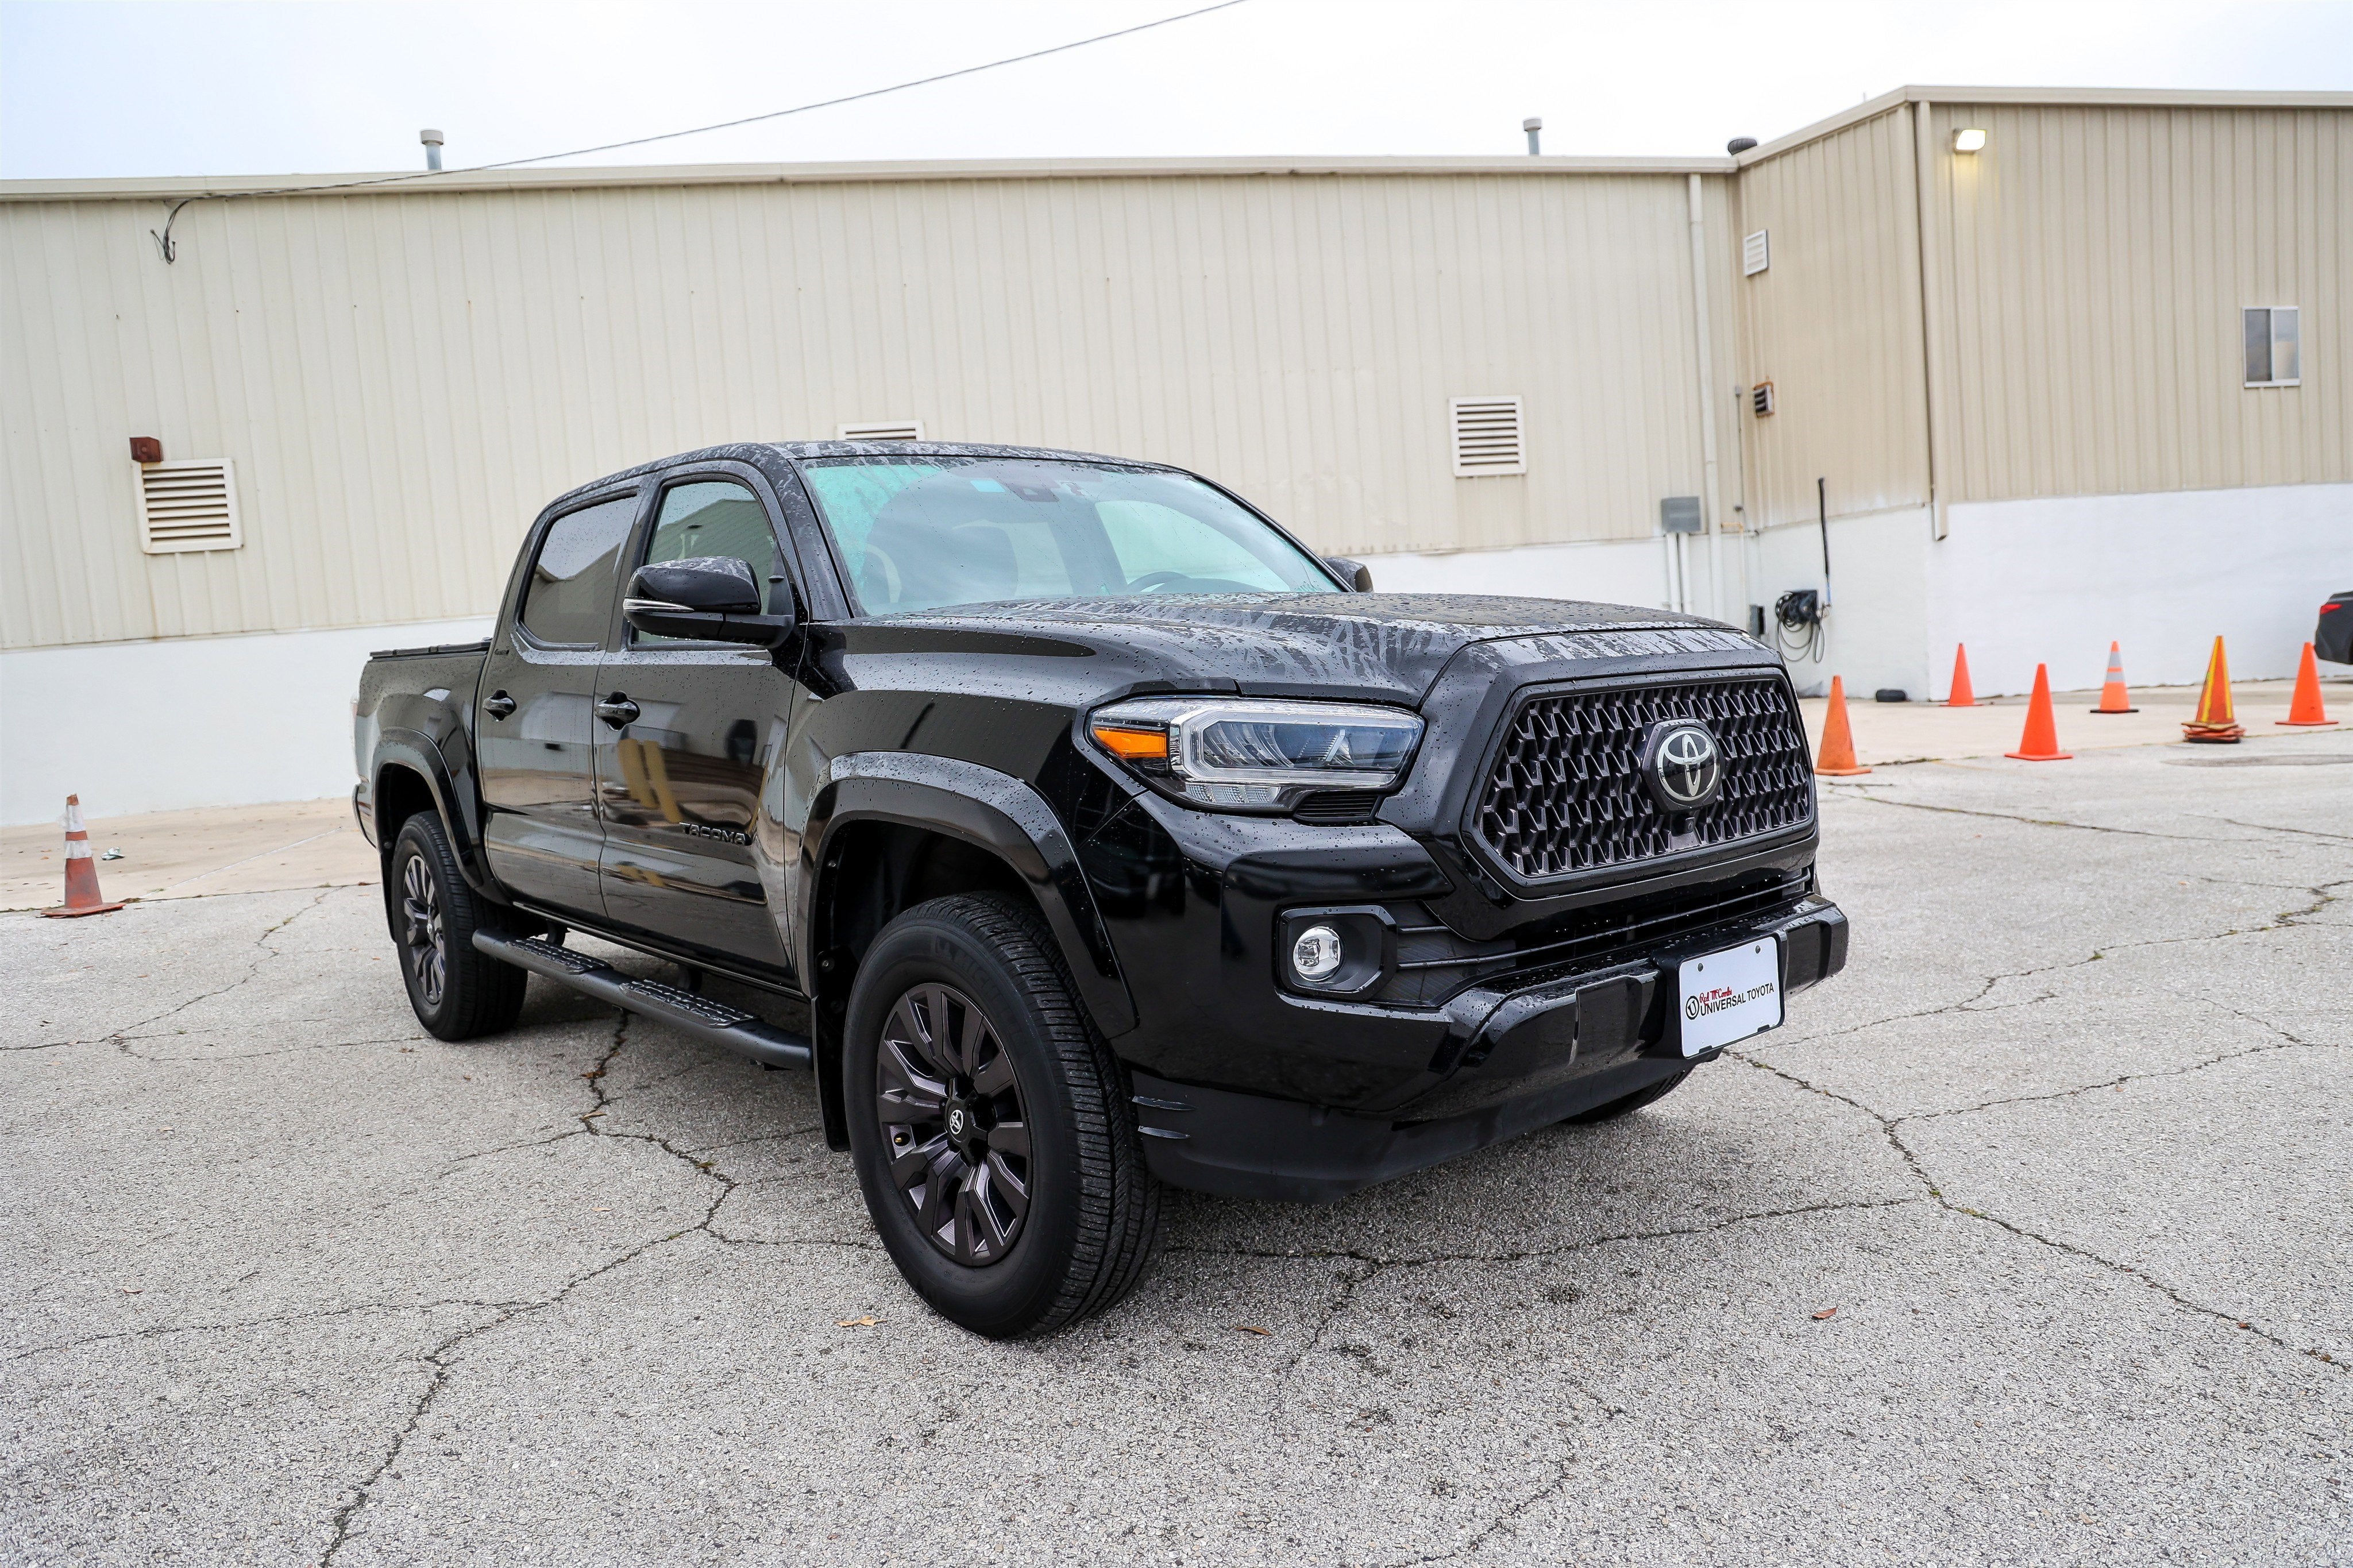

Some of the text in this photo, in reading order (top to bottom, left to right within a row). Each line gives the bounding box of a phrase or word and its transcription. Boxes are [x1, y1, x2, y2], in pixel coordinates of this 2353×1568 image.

[679, 822, 749, 845] TACOMA
[1699, 992, 1710, 1006] Red
[1700, 982, 1775, 1016] UNIVERSAL TOYOTA
